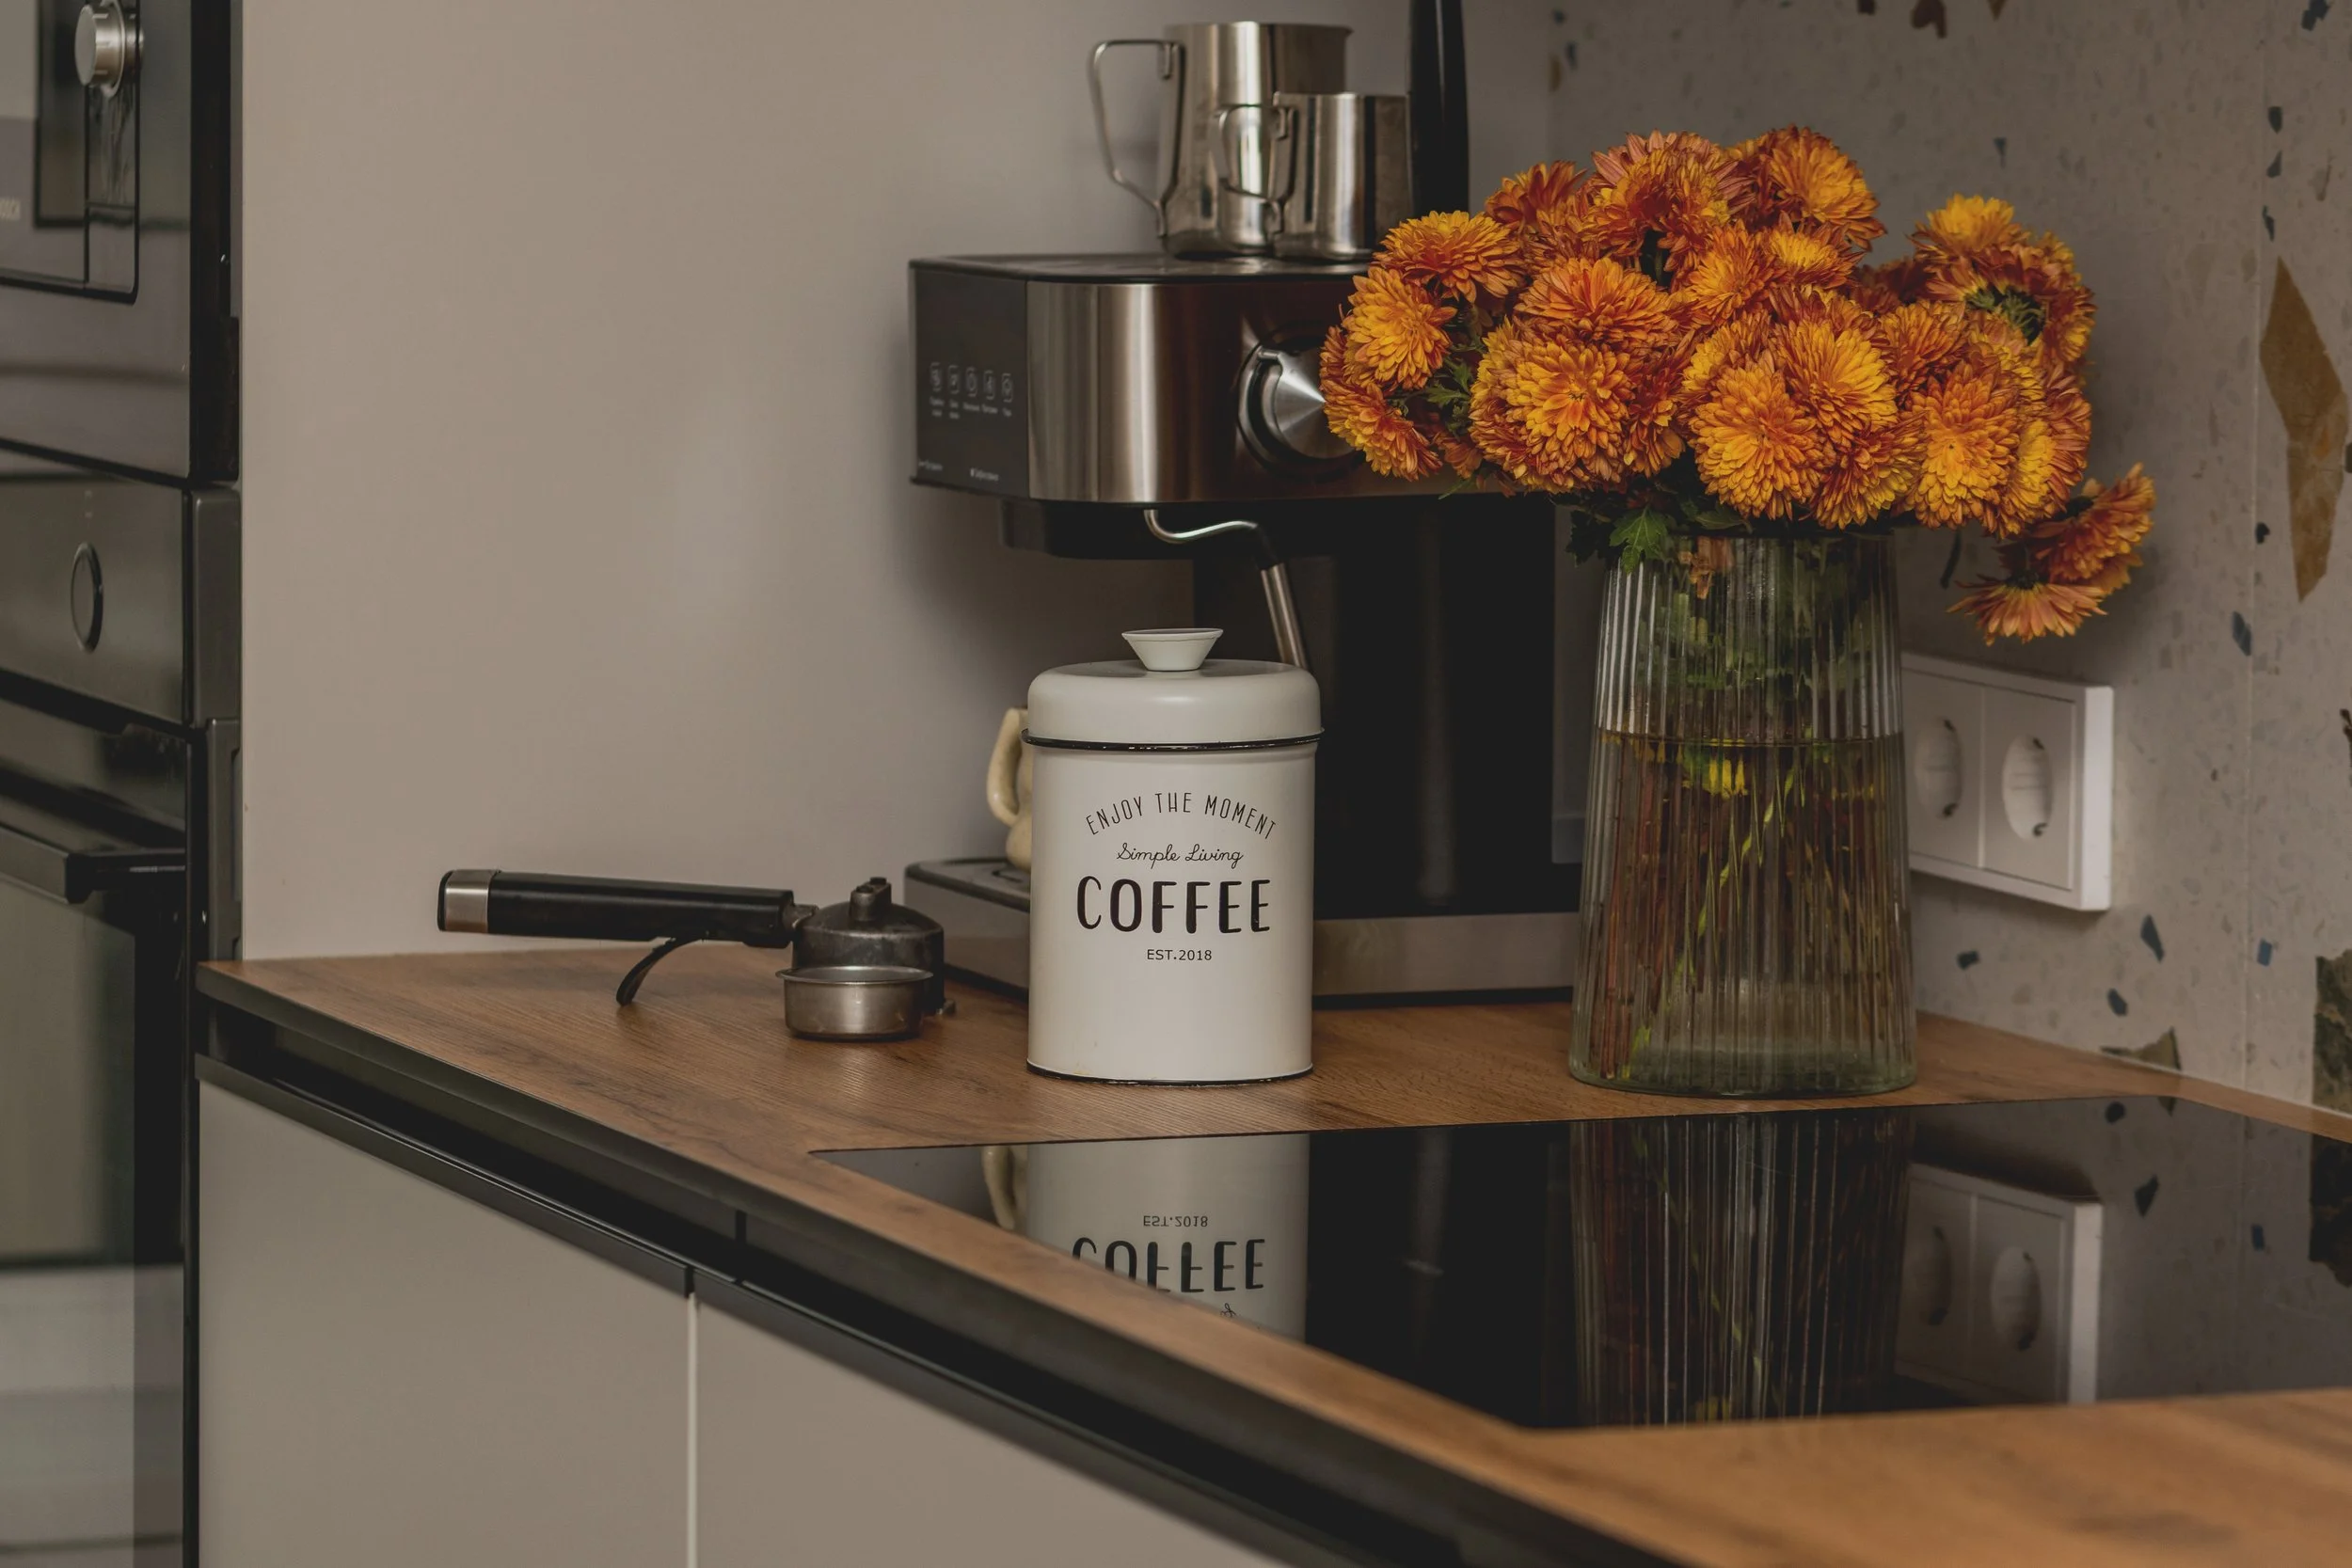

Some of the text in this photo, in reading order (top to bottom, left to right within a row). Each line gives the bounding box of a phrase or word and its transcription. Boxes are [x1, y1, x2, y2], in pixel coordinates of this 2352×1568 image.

[1086, 792, 1278, 840] ENJOY THE MOMENT
[1116, 842, 1245, 870] Simple Living
[1076, 875, 1271, 935] COFFEE
[1146, 948, 1213, 961] EST.2018
